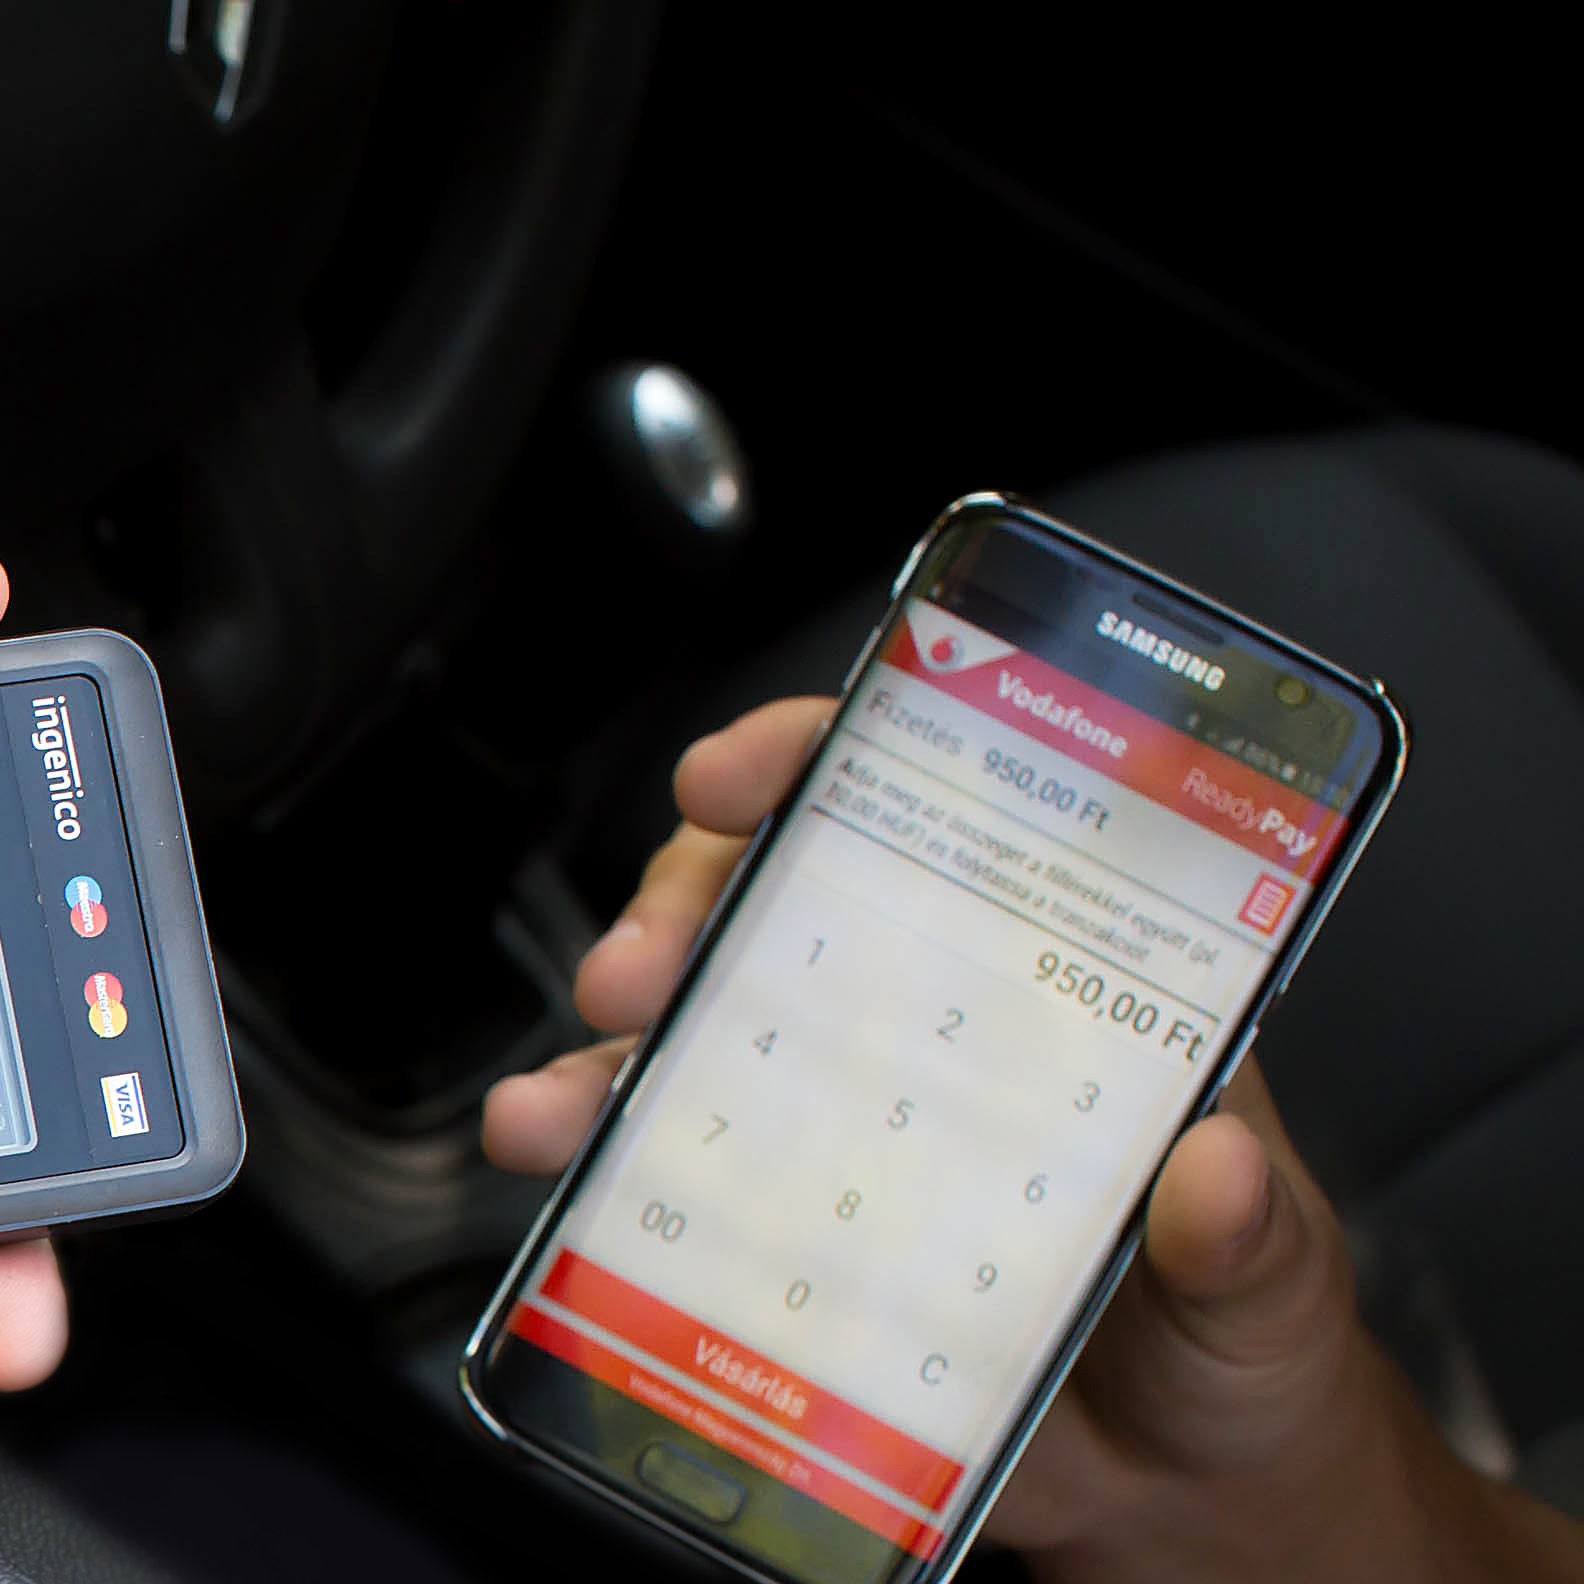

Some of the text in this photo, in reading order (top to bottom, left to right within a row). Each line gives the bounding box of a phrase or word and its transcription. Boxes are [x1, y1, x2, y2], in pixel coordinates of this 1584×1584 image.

[1096, 611, 1226, 691] SAMSUNG
[996, 670, 1127, 758] Vodafone
[31, 695, 85, 840] ingenico
[984, 749, 1077, 811] 950,00
[1078, 800, 1110, 831] Ft
[807, 938, 825, 968] 1
[1034, 950, 1205, 1063] 950,00 Ft
[752, 1027, 778, 1058] 4
[936, 1008, 964, 1043] 2
[115, 1083, 133, 1127] VISA
[887, 1098, 915, 1131] 5
[1074, 1081, 1100, 1114] 3
[702, 1116, 730, 1146] 7
[835, 1188, 863, 1221] 8
[1024, 1172, 1050, 1205] 6
[639, 1200, 687, 1244] 00
[785, 1279, 812, 1312] 0
[973, 1263, 999, 1295] 9
[920, 1352, 949, 1387] C
